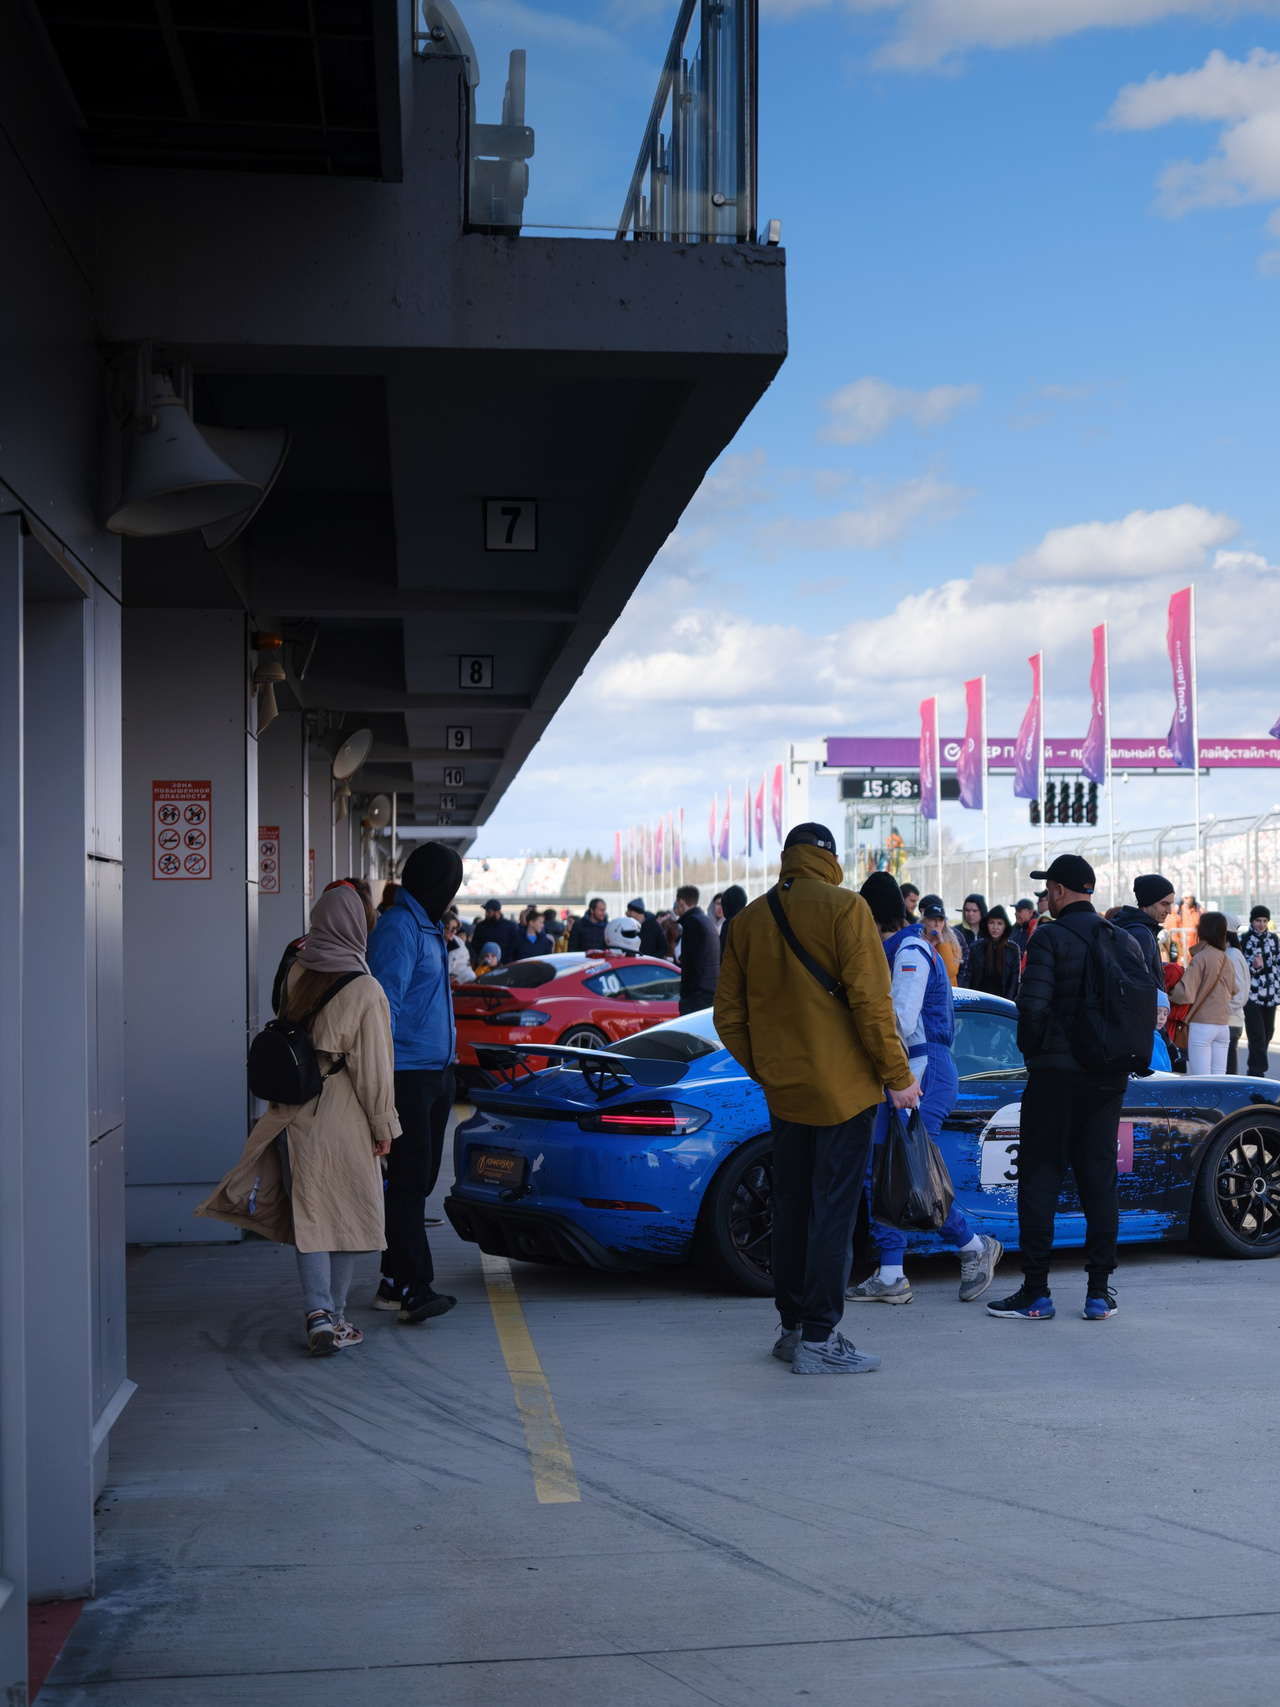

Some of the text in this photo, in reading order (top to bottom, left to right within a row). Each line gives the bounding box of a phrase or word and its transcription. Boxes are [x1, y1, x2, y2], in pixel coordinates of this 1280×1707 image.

[501, 506, 521, 544] 7
[470, 660, 483, 684] 8
[454, 730, 465, 748] 9
[446, 770, 462, 785] 10
[442, 796, 455, 808] 11
[599, 974, 620, 994] 10
